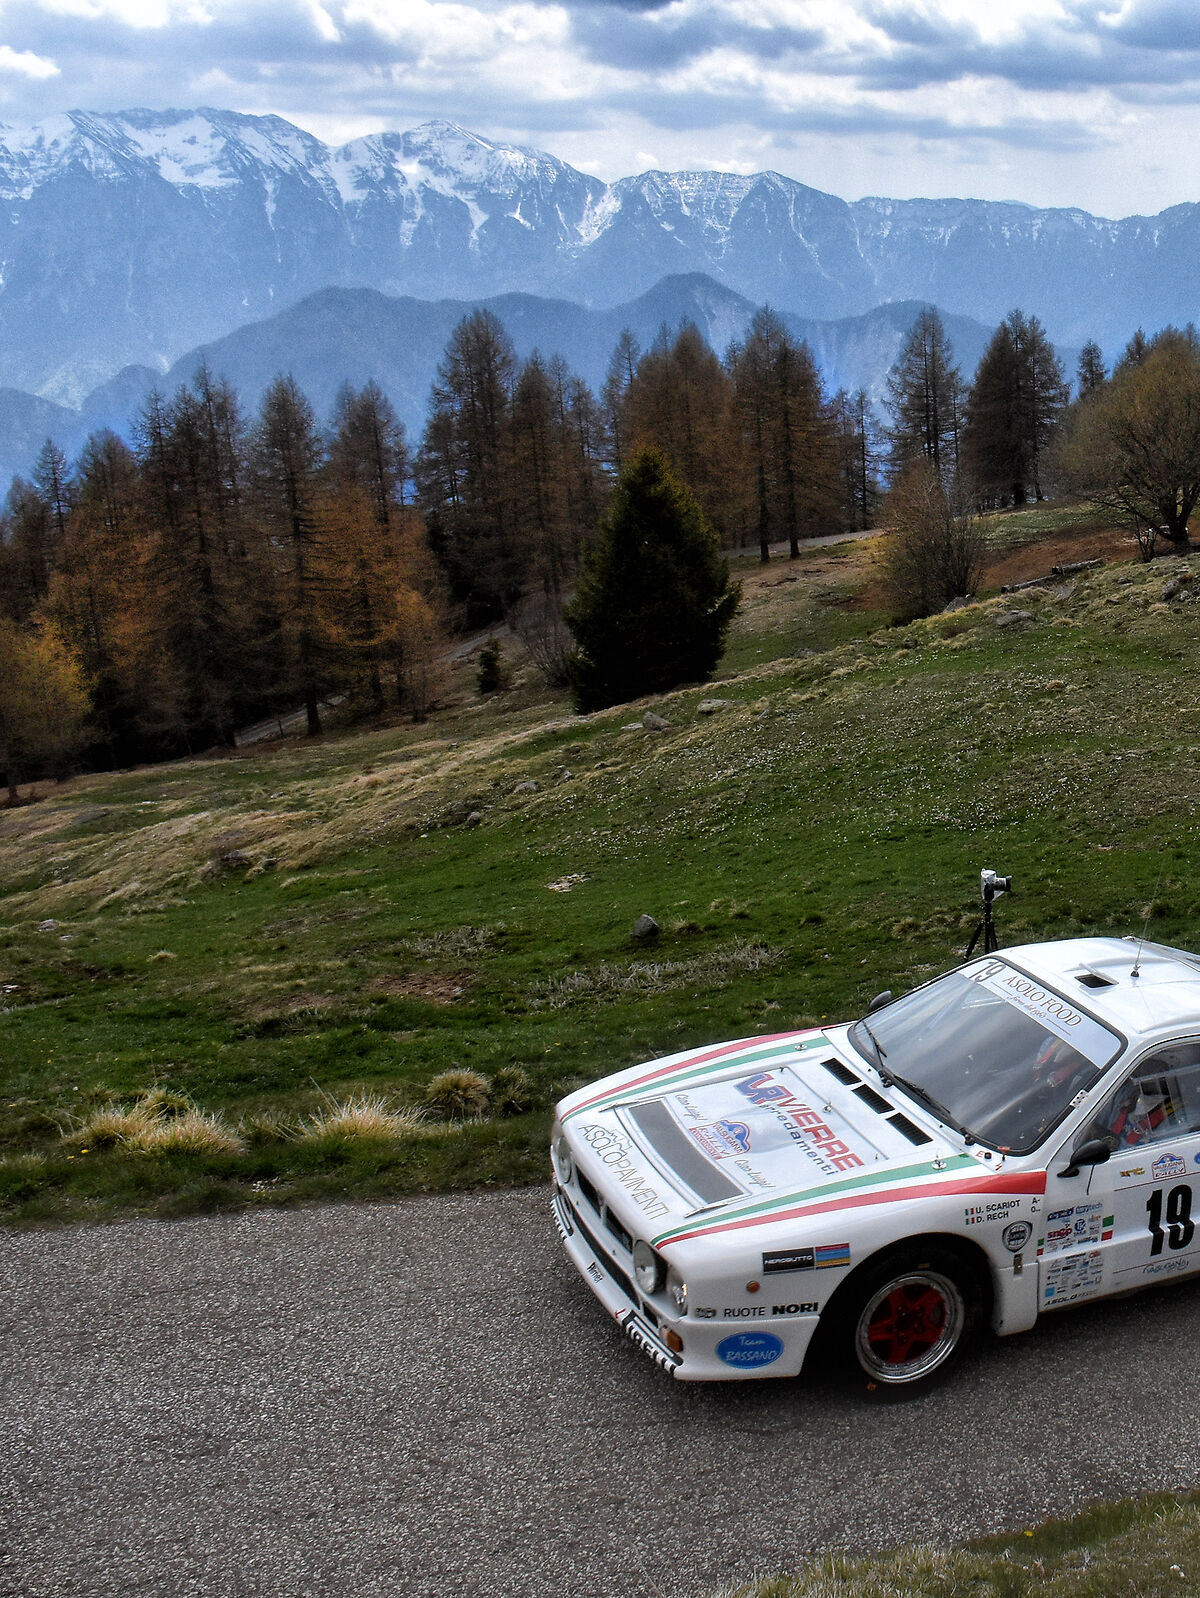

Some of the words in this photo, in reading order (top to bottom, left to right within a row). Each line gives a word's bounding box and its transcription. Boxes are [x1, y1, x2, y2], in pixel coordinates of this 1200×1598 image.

[968, 961, 1007, 982] 19
[1002, 975, 1046, 1002] ASOLO
[1040, 998, 1082, 1026] FOOD
[760, 1104, 839, 1176] arredamenti
[777, 1097, 865, 1171] VIERRE
[975, 1206, 984, 1214] U.
[986, 1199, 1021, 1212] SCARIOT
[986, 1210, 1009, 1221] RECH
[1146, 1184, 1195, 1256] 19
[723, 1306, 767, 1318] RUOTE
[772, 1302, 819, 1315] NORI
[739, 1336, 766, 1346] Team
[726, 1350, 778, 1362] BASSANO
